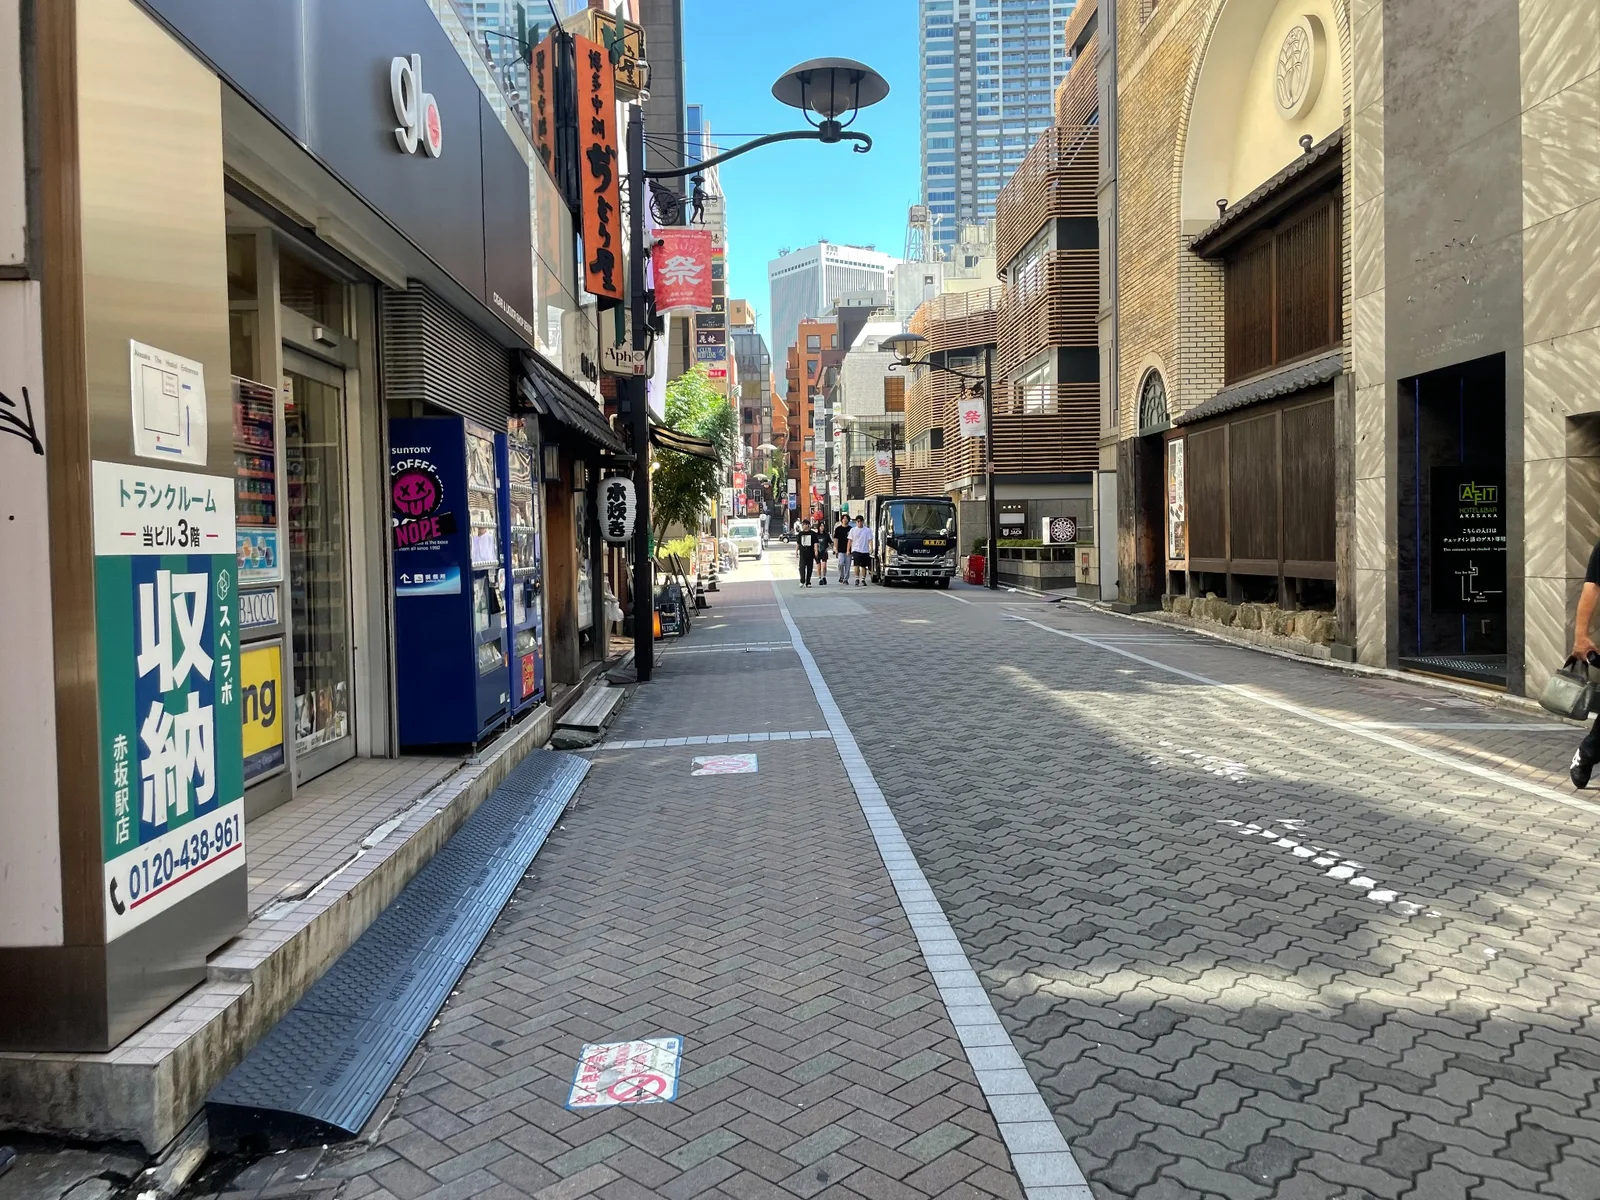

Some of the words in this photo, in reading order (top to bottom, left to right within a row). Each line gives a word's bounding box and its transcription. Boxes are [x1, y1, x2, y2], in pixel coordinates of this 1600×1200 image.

[658, 255, 705, 286] 祭
[154, 355, 162, 365] The
[963, 410, 981, 424] 祭
[119, 479, 217, 513] トランクルーム
[606, 482, 627, 538] 水炊き
[142, 518, 201, 548] 当ビル3階
[395, 516, 441, 548] NOPE
[219, 605, 233, 705] スペラボ
[137, 570, 216, 827] 収納
[114, 734, 130, 845] 赤坂駅店
[129, 814, 240, 900] 0120-438-961
